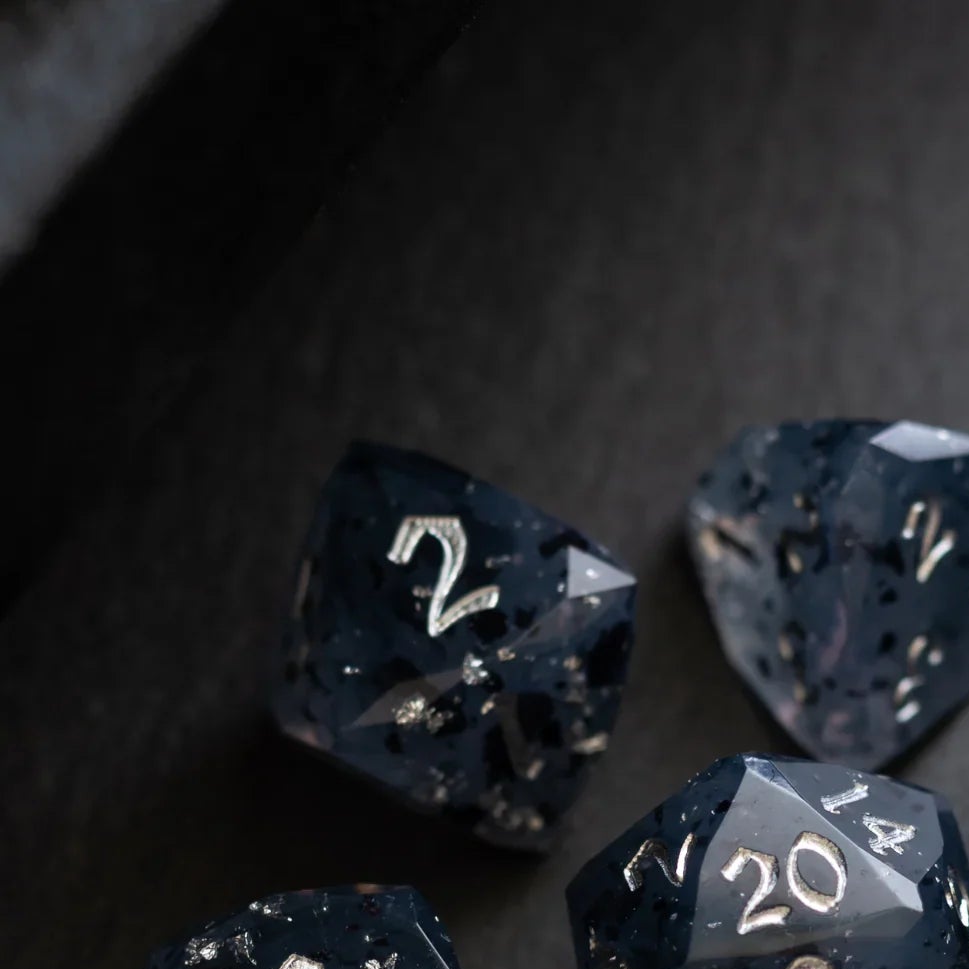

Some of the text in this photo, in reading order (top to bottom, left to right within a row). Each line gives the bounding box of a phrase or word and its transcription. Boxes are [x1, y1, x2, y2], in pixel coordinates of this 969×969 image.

[387, 515, 501, 638] 2
[623, 831, 697, 893] 2
[820, 781, 918, 857] 14
[720, 831, 849, 935] 20
